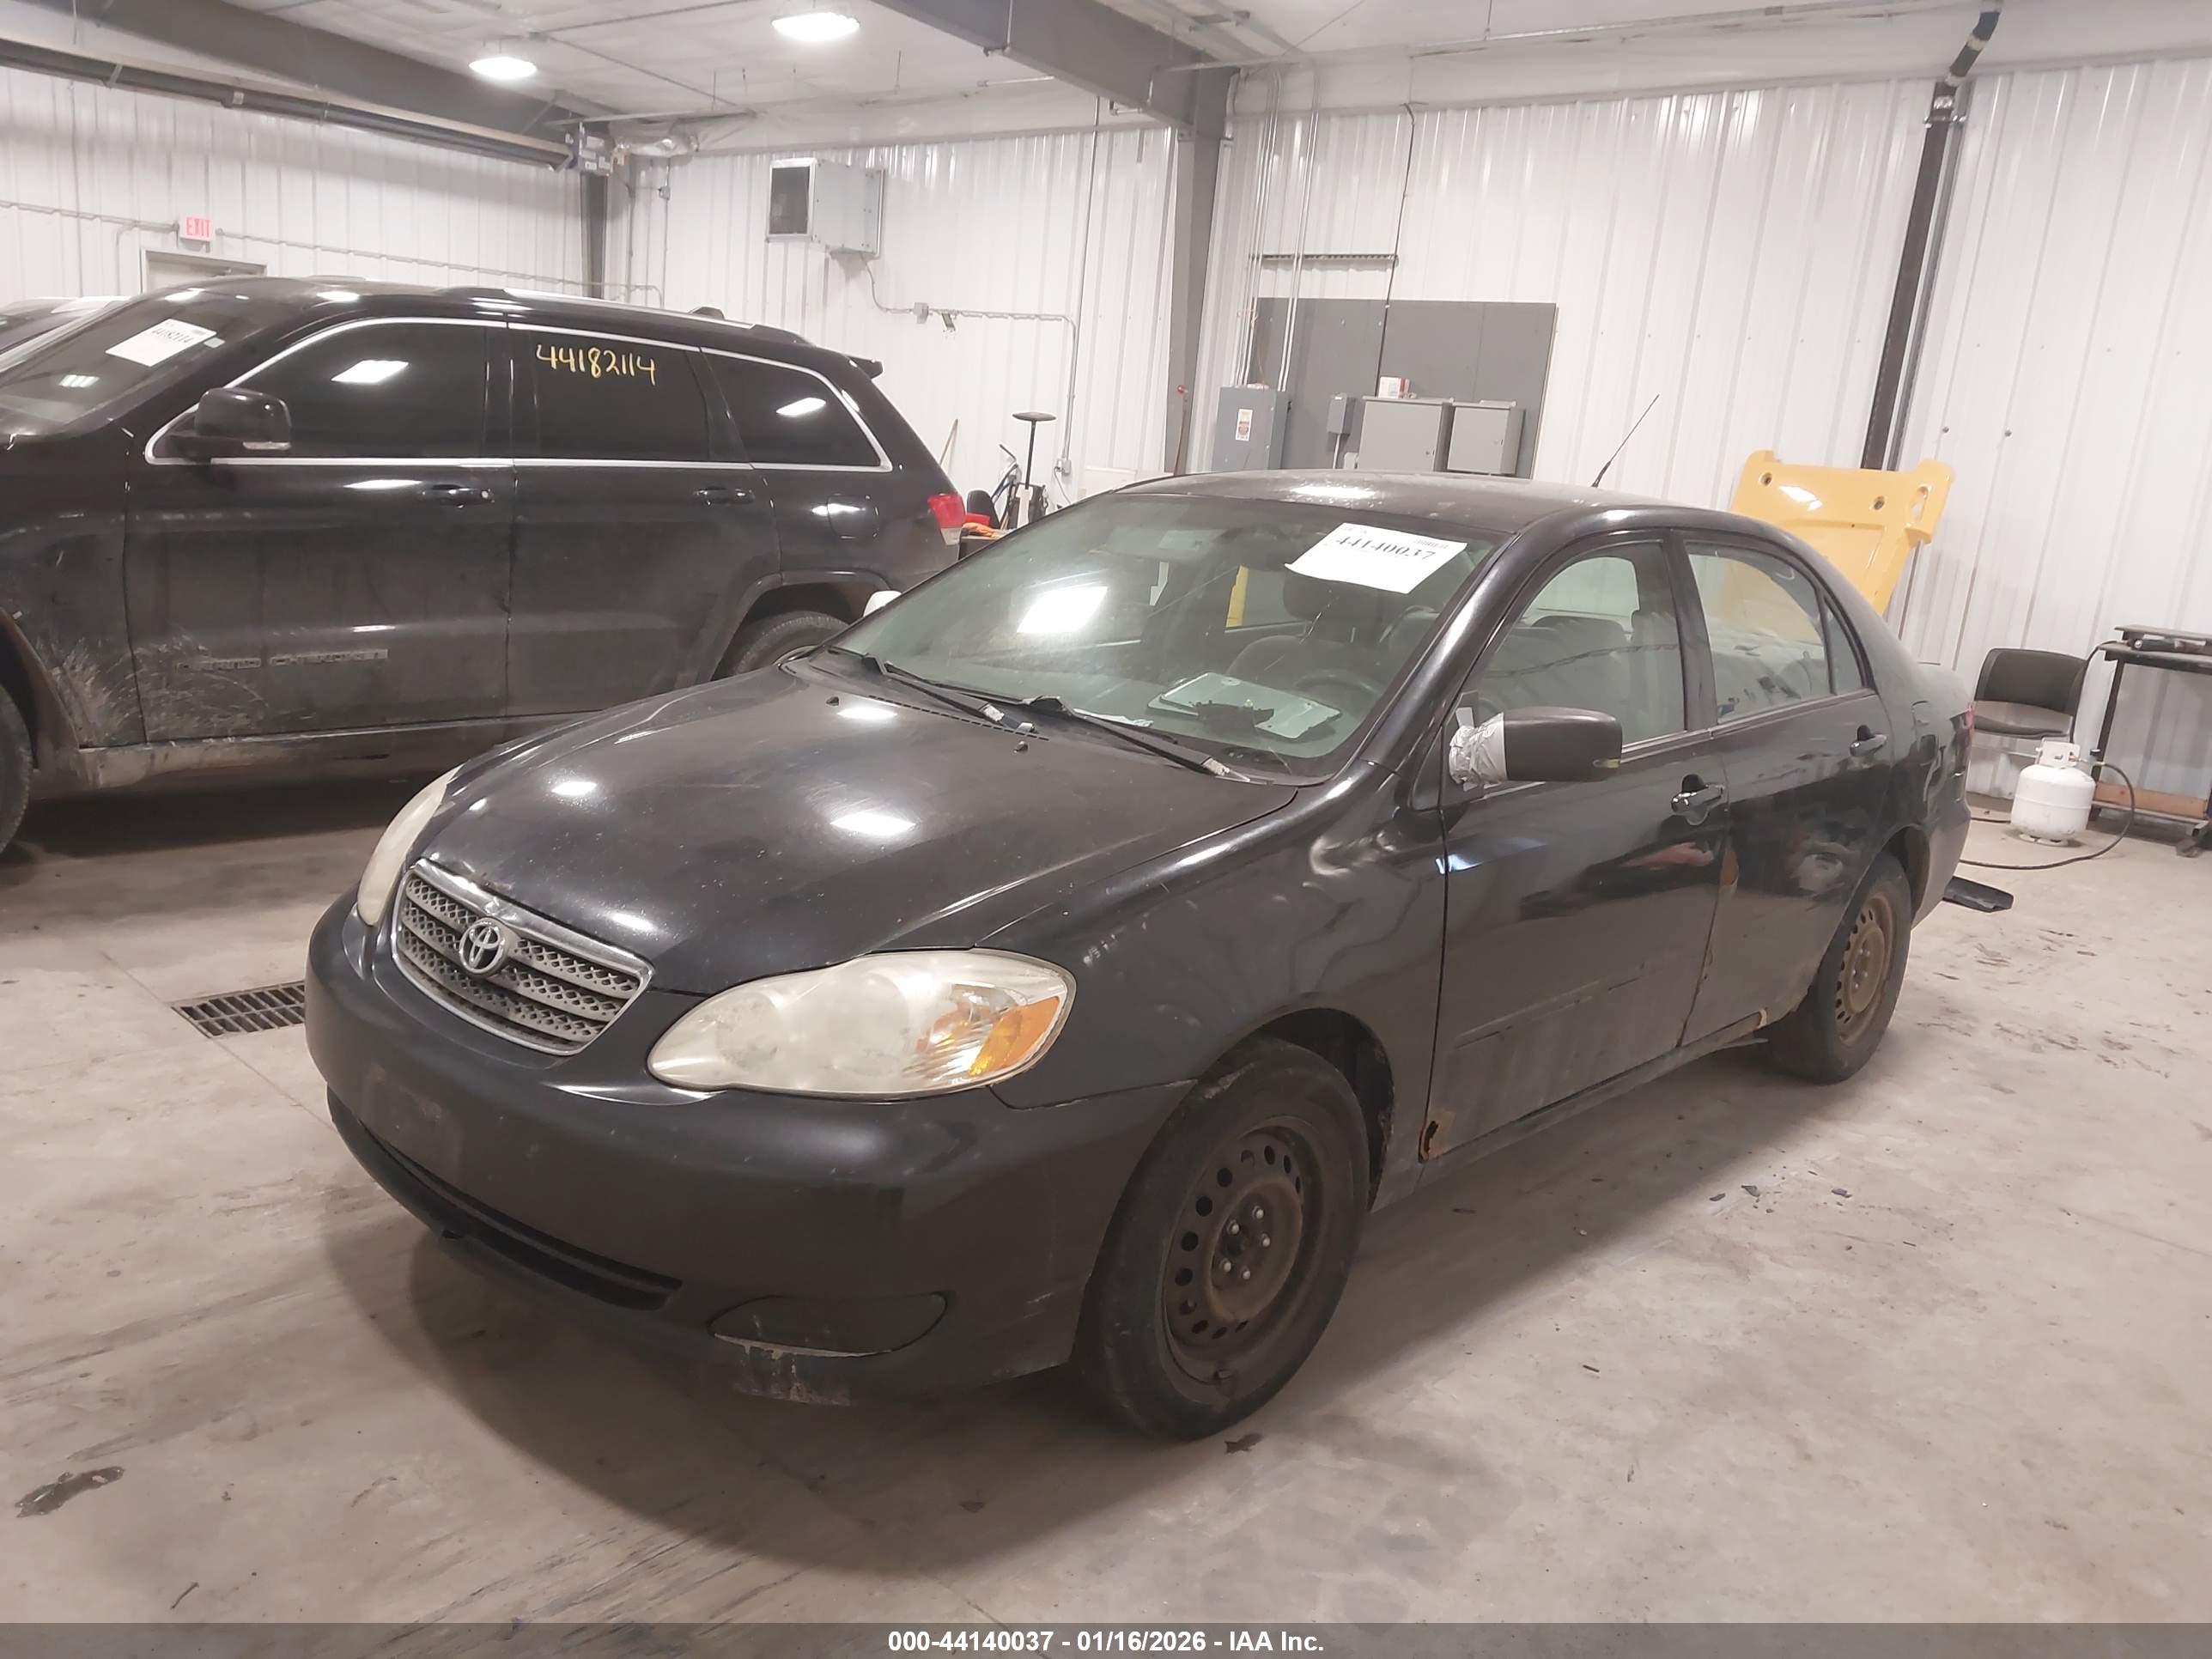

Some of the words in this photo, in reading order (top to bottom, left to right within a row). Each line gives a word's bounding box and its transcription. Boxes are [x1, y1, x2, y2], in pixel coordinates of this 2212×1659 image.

[185, 216, 210, 238] EXIT
[536, 344, 655, 386] 44182114
[1335, 536, 1437, 560] 44140037
